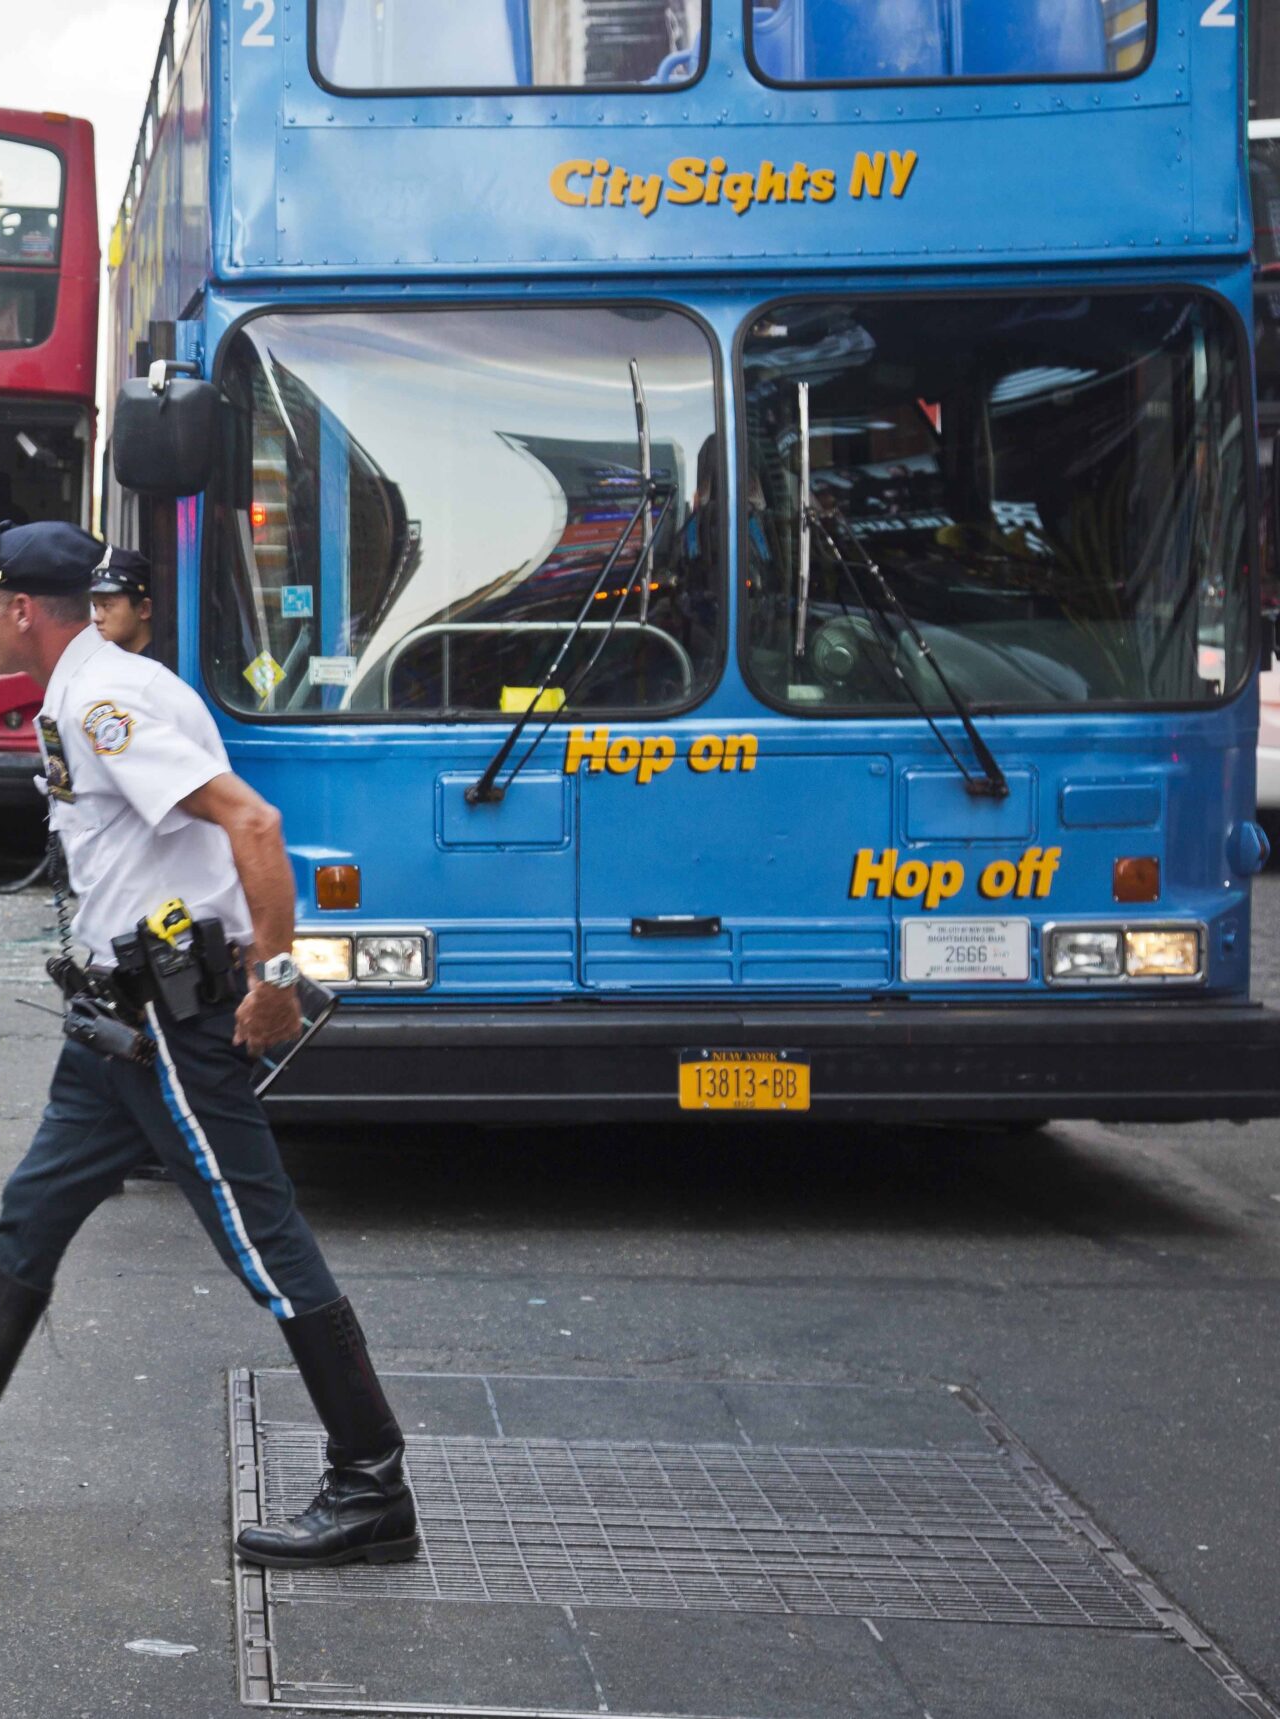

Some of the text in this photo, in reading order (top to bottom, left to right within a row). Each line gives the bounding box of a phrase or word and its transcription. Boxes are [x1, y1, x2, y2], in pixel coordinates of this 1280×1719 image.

[241, 0, 274, 47] 2
[848, 150, 917, 198] NY
[564, 725, 759, 784] Hop on
[850, 846, 1062, 909] Hop off
[945, 945, 988, 963] 2666
[712, 1051, 778, 1062] NEW YORK
